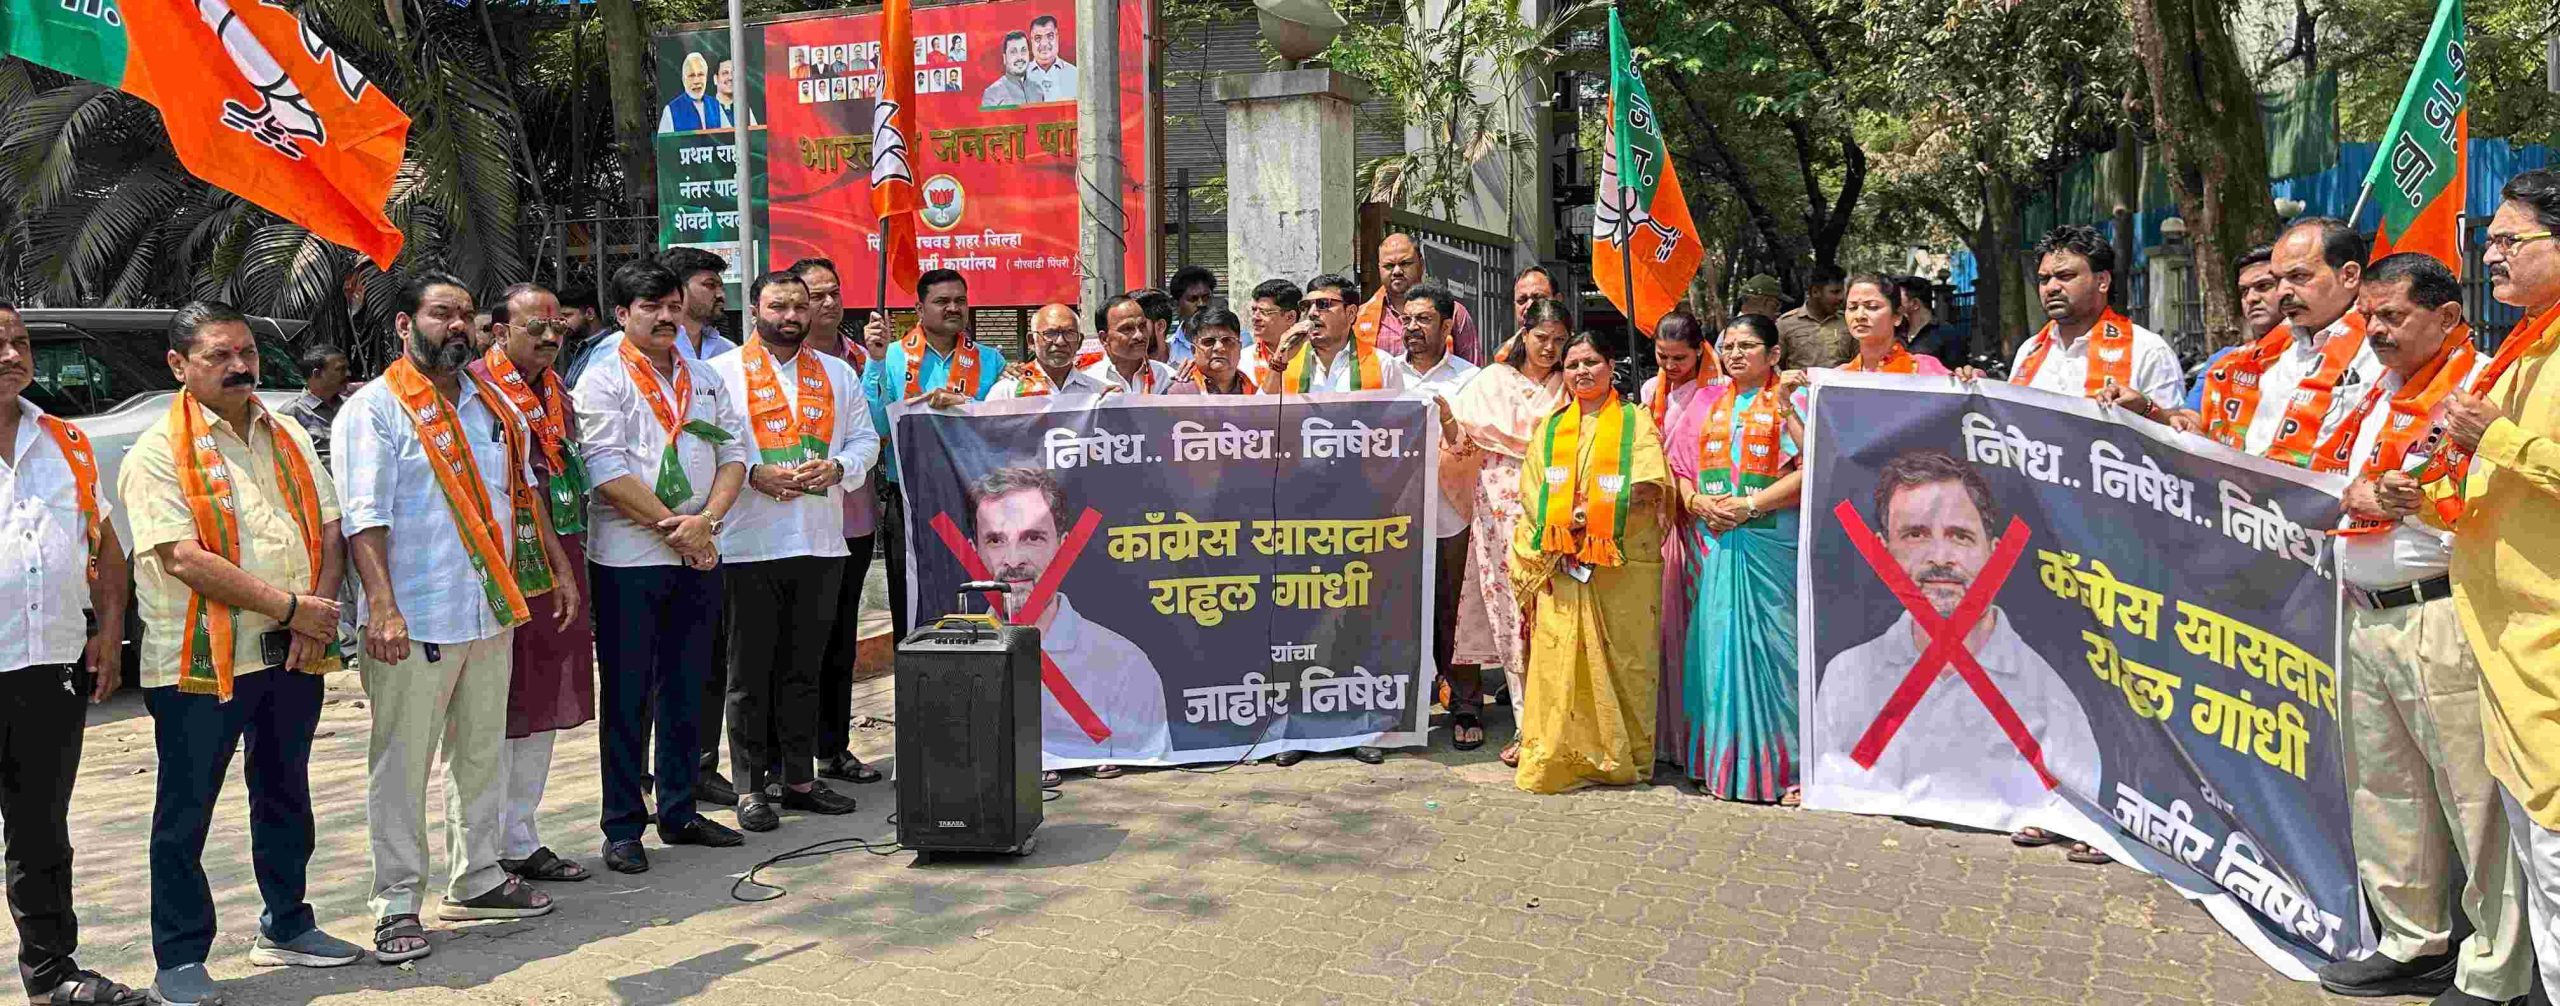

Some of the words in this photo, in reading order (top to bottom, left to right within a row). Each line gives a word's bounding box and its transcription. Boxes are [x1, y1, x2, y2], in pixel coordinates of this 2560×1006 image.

[679, 144, 714, 165] प्रथम
[929, 123, 1028, 163] जनता
[679, 177, 712, 199] नंतर
[674, 206, 713, 233] शेवटी
[955, 233, 981, 249] शहर
[984, 229, 1023, 249] जिल्हा
[943, 251, 997, 272] कार्यालय
[1250, 514, 1412, 558] खासदार
[1148, 573, 1261, 627] राहुल
[1271, 561, 1374, 611] गांधी
[1270, 642, 1318, 664] यांचा
[2173, 599, 2338, 722] खासदार
[1182, 671, 1294, 728] जाहीर
[1299, 665, 1410, 715] निषेध
[2190, 684, 2311, 782] गांधी
